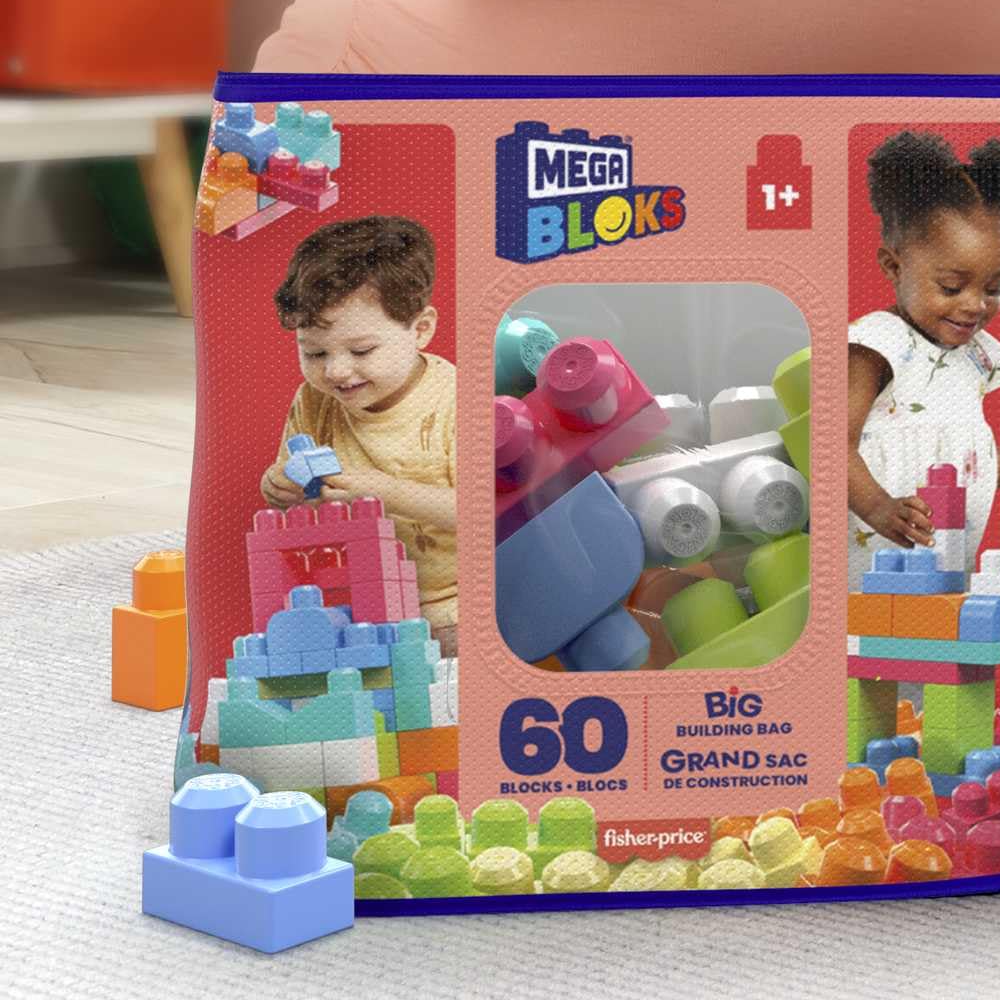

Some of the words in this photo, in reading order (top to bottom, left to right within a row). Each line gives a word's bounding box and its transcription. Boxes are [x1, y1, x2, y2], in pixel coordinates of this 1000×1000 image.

[534, 147, 625, 191] MEGA
[761, 184, 800, 211] 1+
[527, 189, 685, 259] BLOKS
[500, 695, 629, 776] 60
[676, 724, 753, 738] BUILDING
[756, 722, 793, 735] BAG
[660, 749, 760, 774] GRAND
[765, 753, 808, 768] SAC
[500, 781, 563, 794] BLOCKS
[576, 779, 628, 792] BLOCS
[663, 778, 684, 790] DE
[686, 774, 808, 789] CONSTRUCTION
[604, 828, 705, 850] fisher-price
